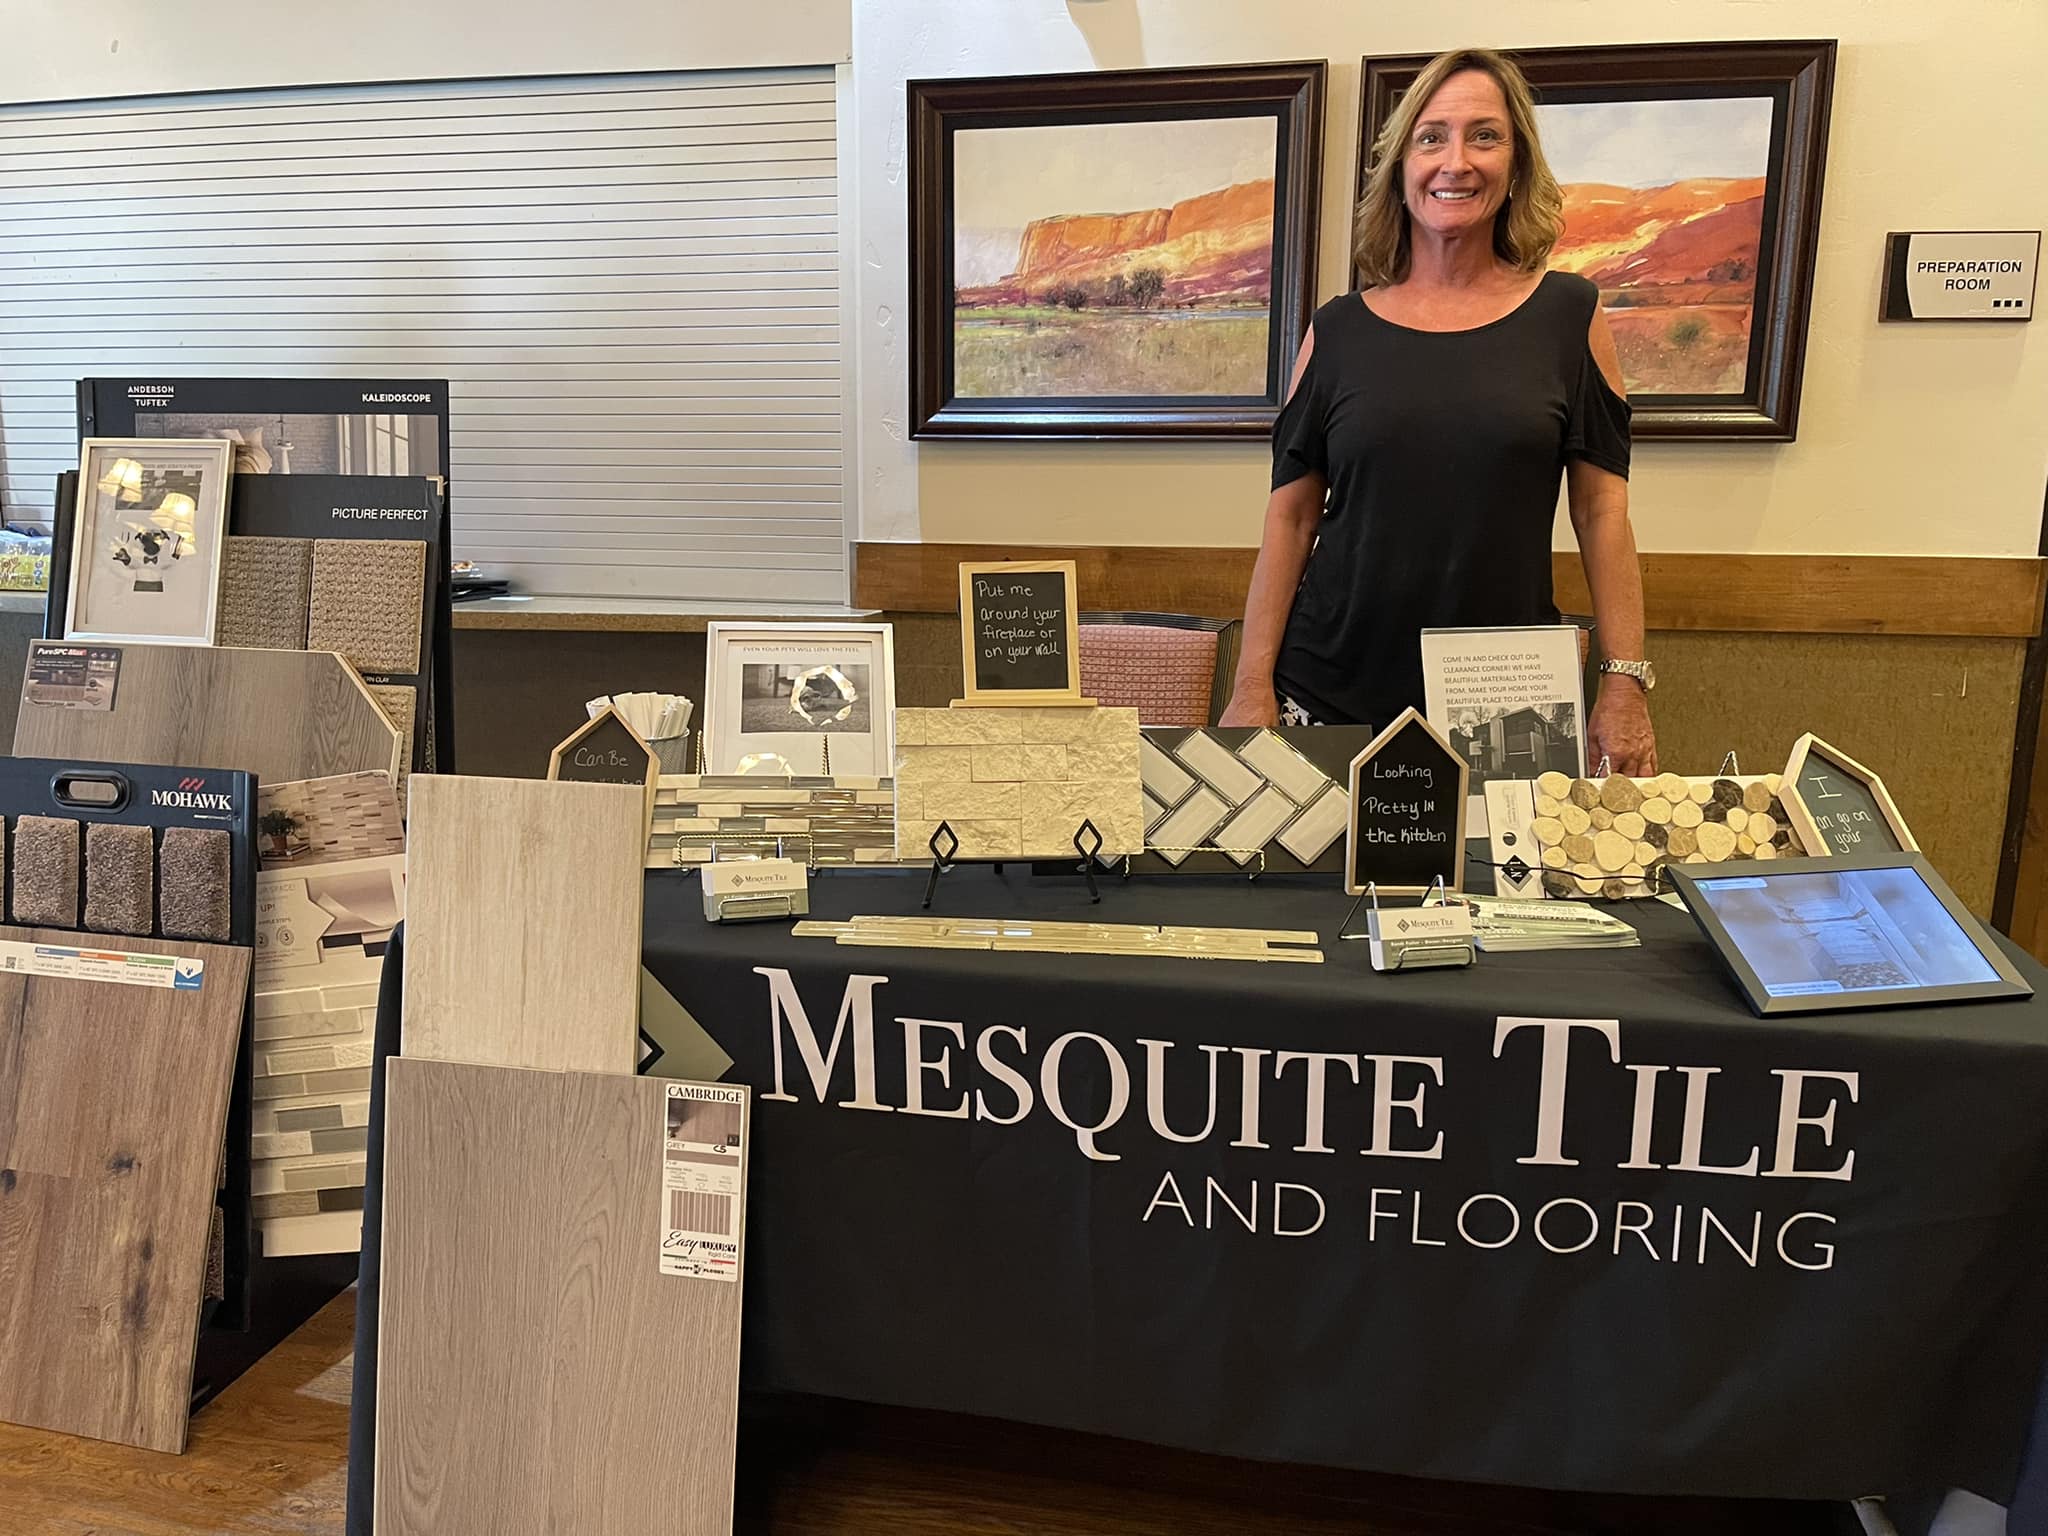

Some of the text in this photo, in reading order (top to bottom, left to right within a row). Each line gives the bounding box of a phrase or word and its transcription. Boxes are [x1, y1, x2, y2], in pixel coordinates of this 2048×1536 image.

[1917, 261, 2022, 273] PREPARATION
[1945, 279, 1991, 290] ROOM
[127, 385, 174, 394] ANDERSON
[361, 393, 432, 403] KALEIDOSCOPE
[135, 398, 168, 407] TUFTEX
[331, 507, 429, 520] PICTURE PERFECT
[976, 580, 1034, 598] Put me
[1033, 609, 1061, 626] your
[982, 624, 1056, 642] fireplace or
[985, 646, 1003, 658] on
[1007, 646, 1032, 664] your
[1443, 666, 1480, 674] CLEARANCE
[1444, 676, 1480, 684] BEAUTIFUL
[1446, 697, 1481, 705] BEAUTIFUL
[574, 747, 629, 767] Can Be
[1808, 775, 1842, 798] I
[151, 789, 232, 811] MOHAWK
[1362, 796, 1419, 820] Pretty
[1836, 812, 1852, 833] go
[1852, 810, 1871, 822] on
[1365, 826, 1397, 844] the
[1834, 831, 1861, 854] your
[1410, 919, 1438, 929] MESQUITE
[1439, 918, 1454, 926] TILE
[752, 966, 1860, 1181] MESQUITE TILE
[668, 1086, 743, 1102] CAMBRIDGE
[1142, 1171, 1326, 1237] AND
[1369, 1188, 1836, 1271] FLOORING
[663, 1230, 736, 1255] Easy LUXURY
